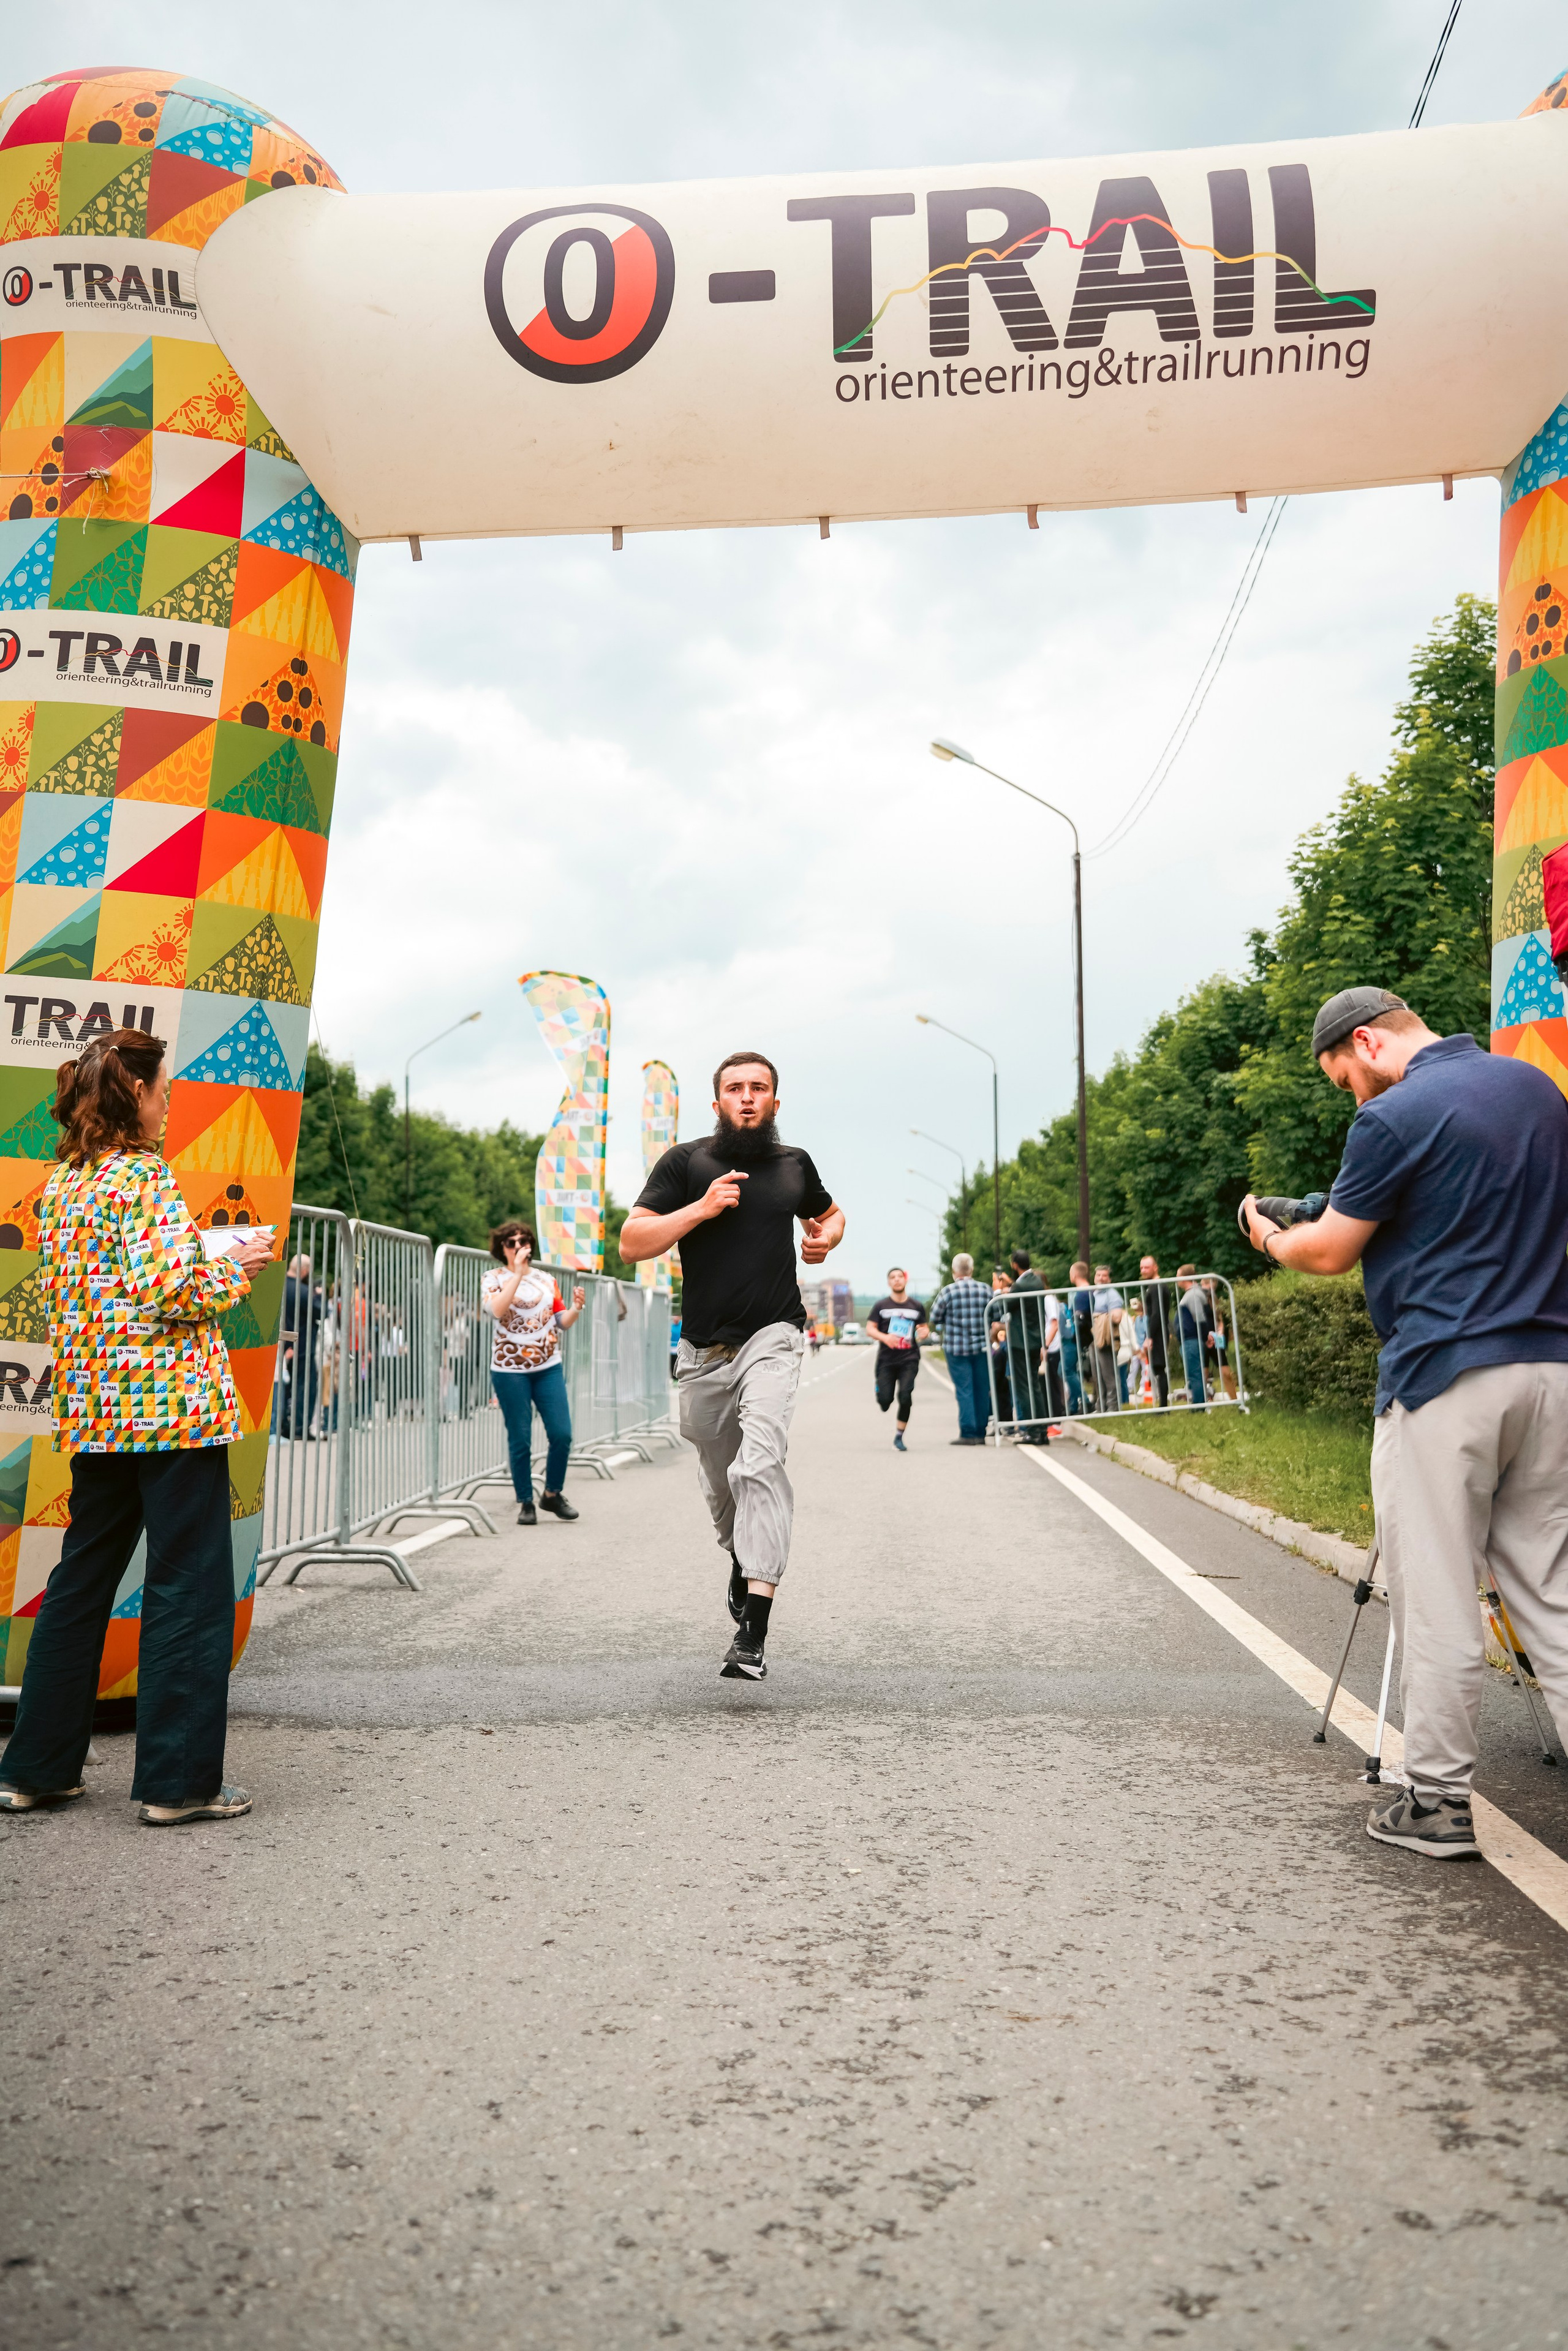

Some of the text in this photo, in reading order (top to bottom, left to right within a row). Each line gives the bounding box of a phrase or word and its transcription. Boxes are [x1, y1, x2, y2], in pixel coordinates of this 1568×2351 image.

[66, 300, 197, 320] orienteering&trailrunning
[835, 333, 1371, 403] orienteering&trailrunning
[56, 672, 212, 698] orienteering&trailrunning
